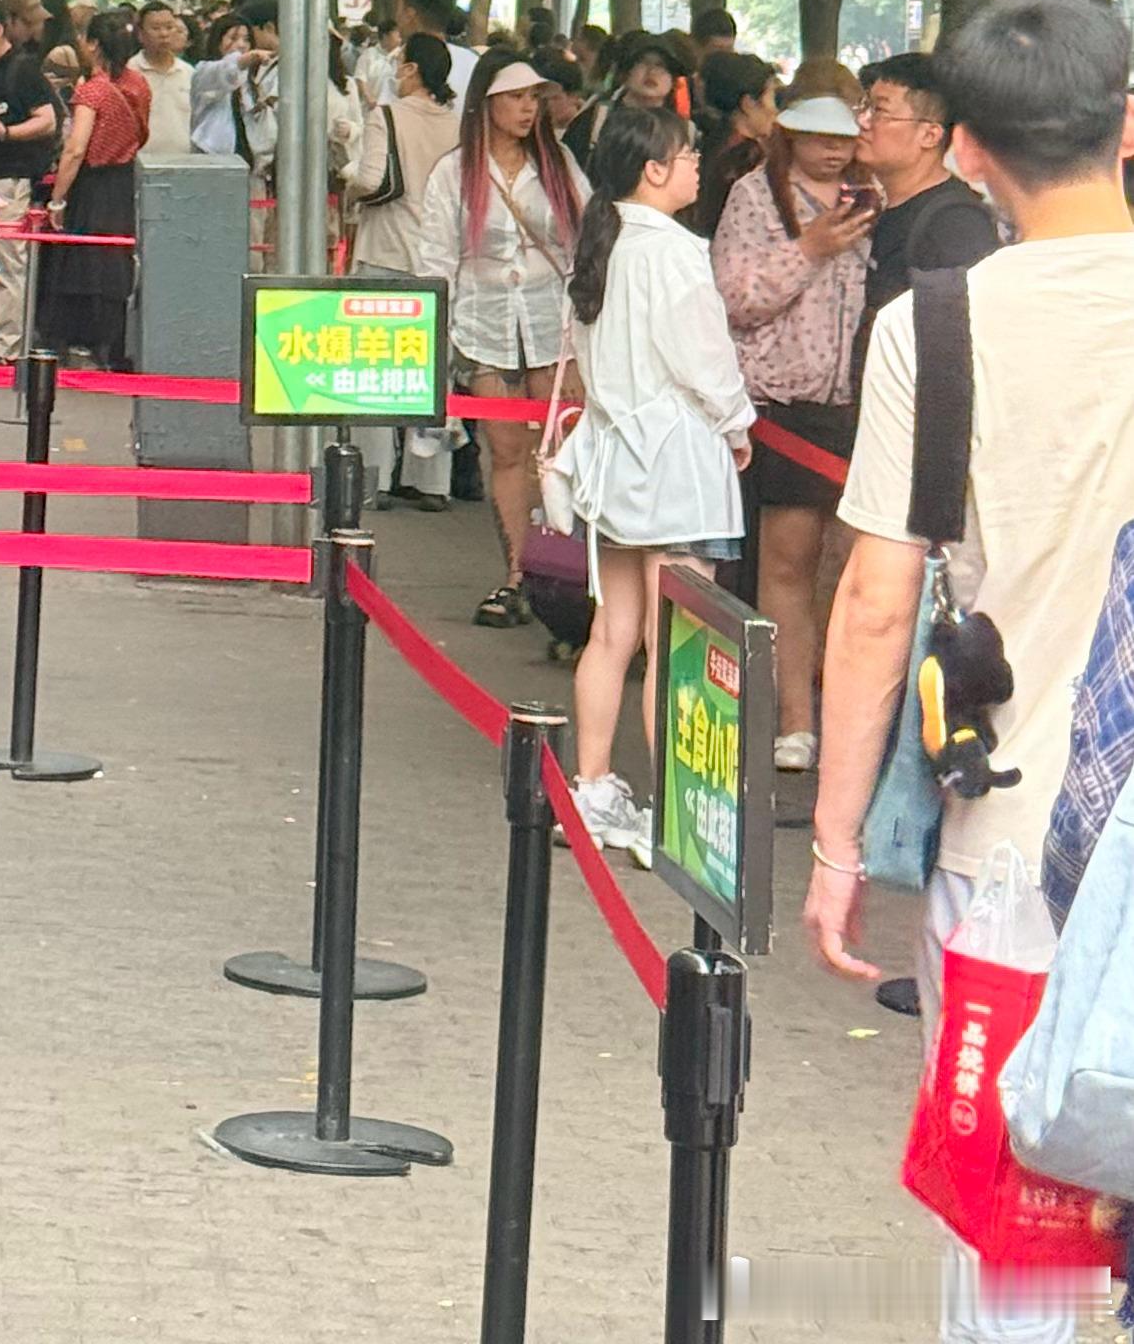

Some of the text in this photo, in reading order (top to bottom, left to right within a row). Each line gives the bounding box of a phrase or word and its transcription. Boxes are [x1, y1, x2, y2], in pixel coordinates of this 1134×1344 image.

[277, 324, 428, 366] 水爆羊肉
[332, 367, 429, 394] 由此排队
